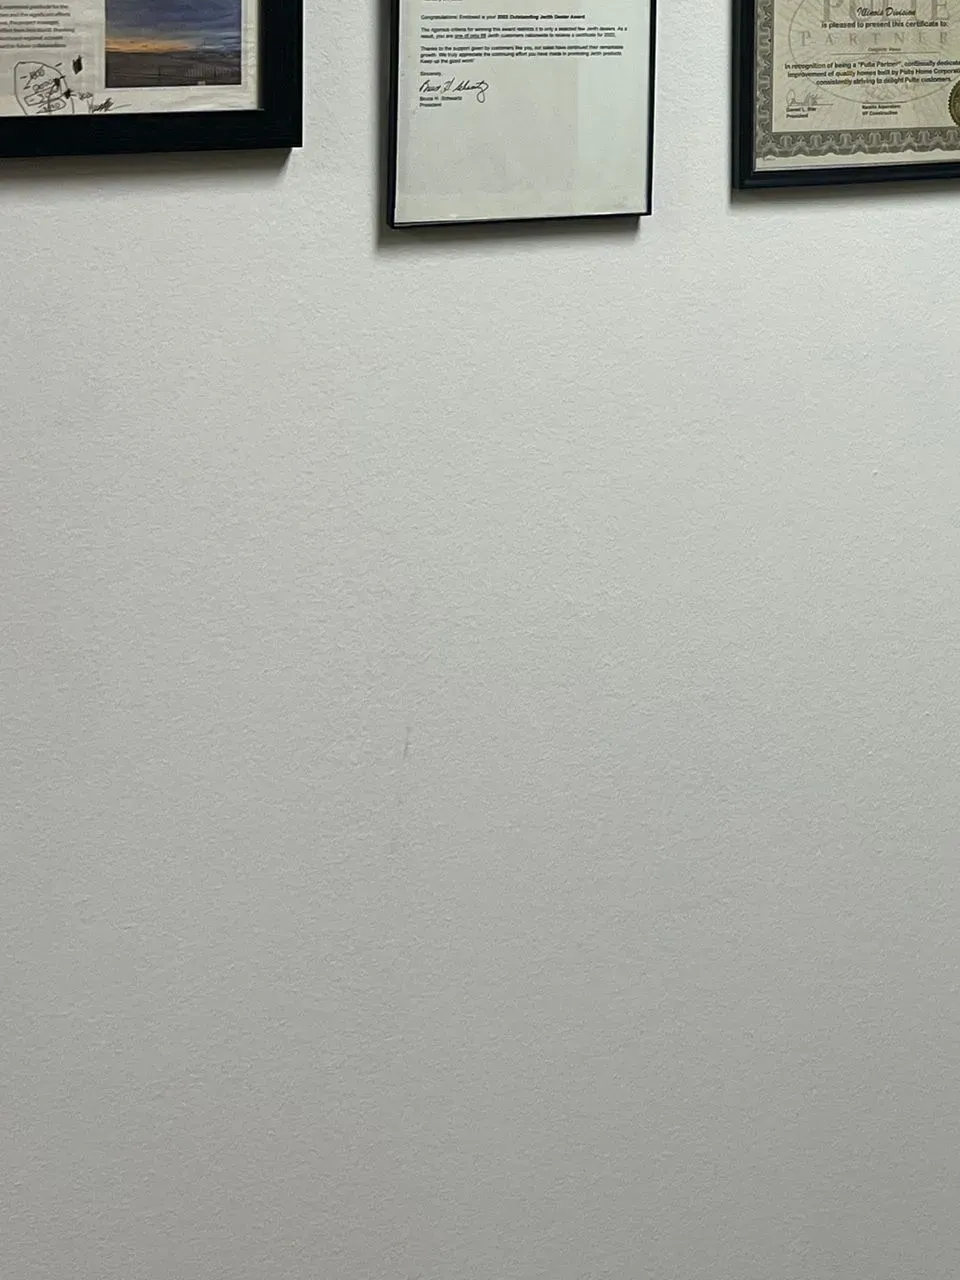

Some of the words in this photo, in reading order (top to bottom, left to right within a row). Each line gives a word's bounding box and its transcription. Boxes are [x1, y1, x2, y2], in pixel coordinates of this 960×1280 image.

[857, 7, 884, 17] Illinois
[885, 7, 916, 16] Division
[822, 21, 827, 29] is
[829, 21, 856, 29] pleased
[865, 21, 891, 29] present
